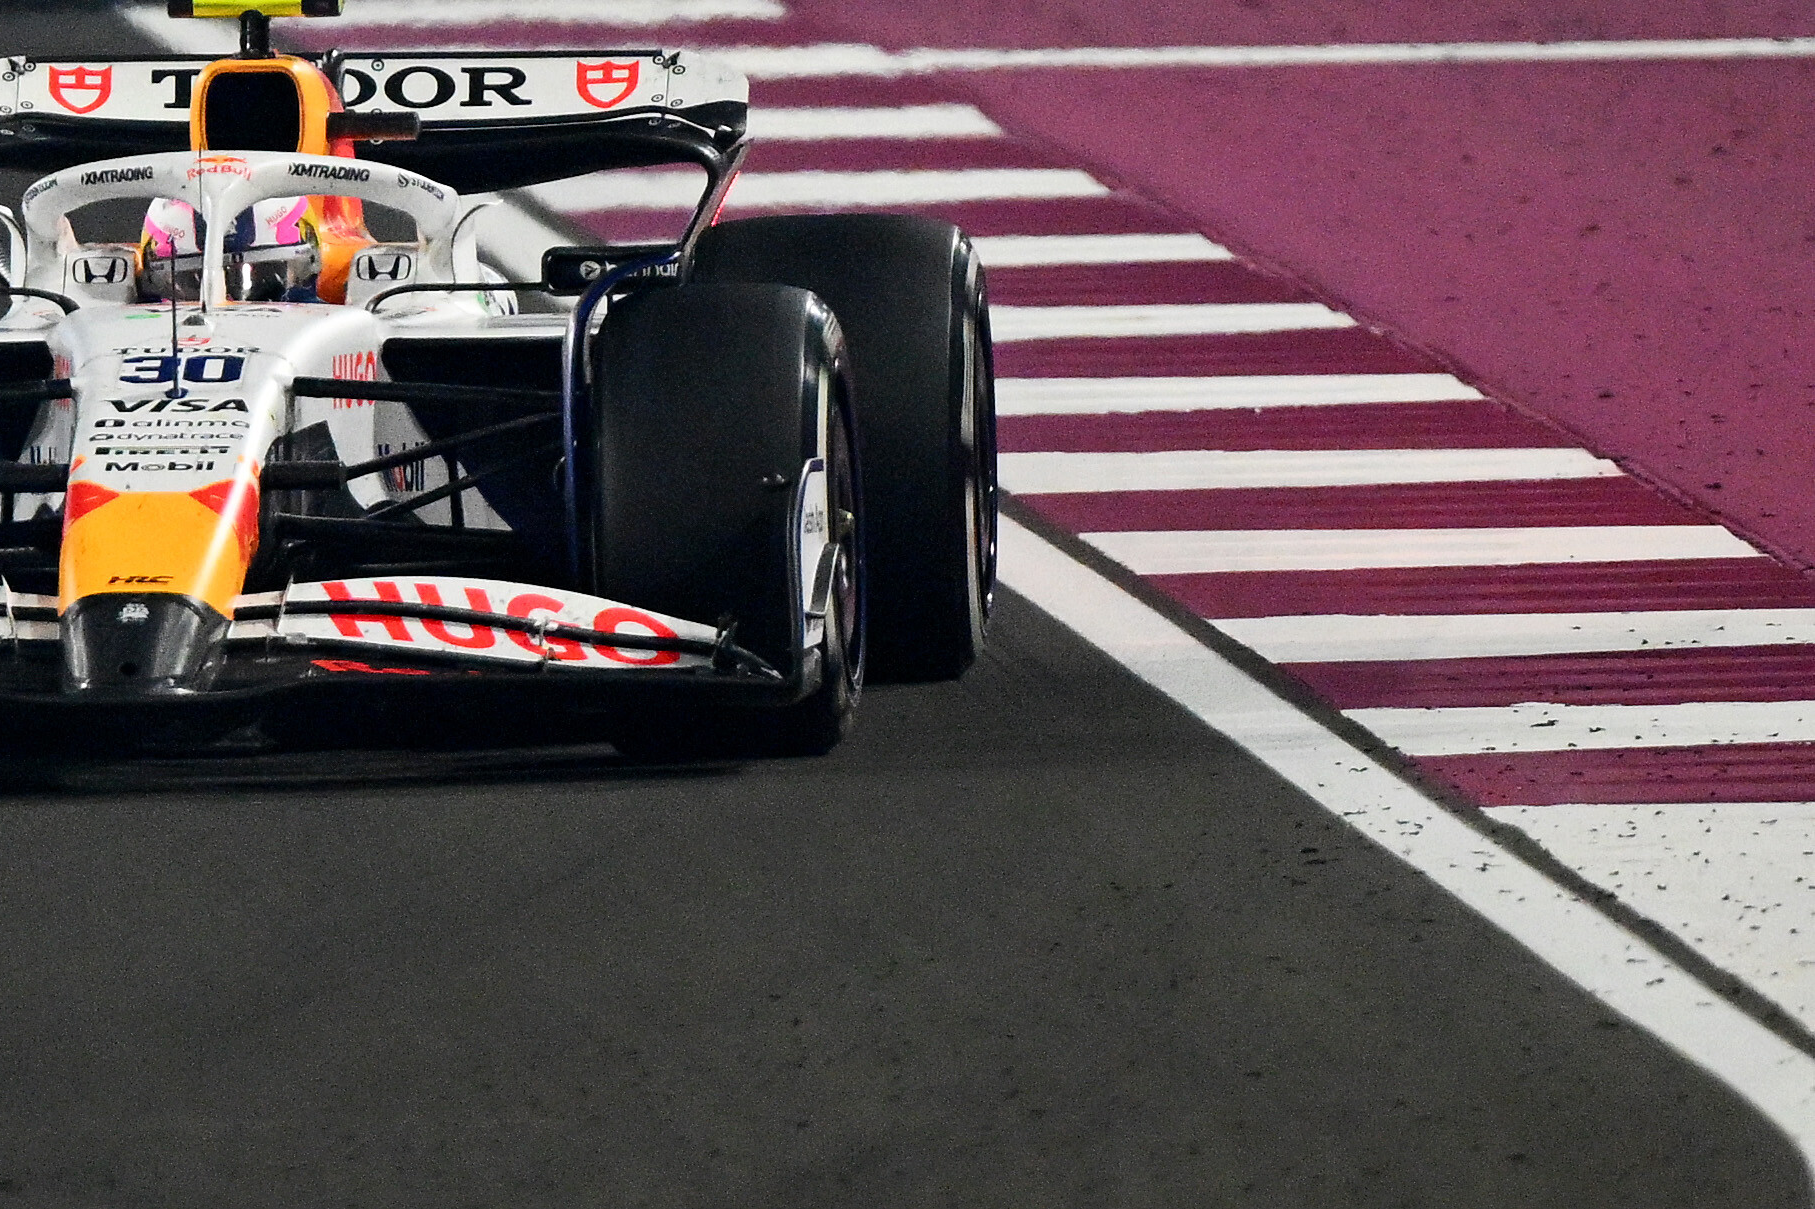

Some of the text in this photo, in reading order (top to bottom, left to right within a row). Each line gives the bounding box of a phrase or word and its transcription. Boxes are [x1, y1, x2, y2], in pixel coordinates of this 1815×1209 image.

[152, 66, 533, 108] TDOR
[119, 355, 245, 383] 30
[332, 350, 377, 409] HUGO
[104, 398, 249, 413] VISA
[117, 432, 244, 442] dynatrace
[105, 461, 214, 472] Mobil
[321, 581, 681, 666] HUGO
